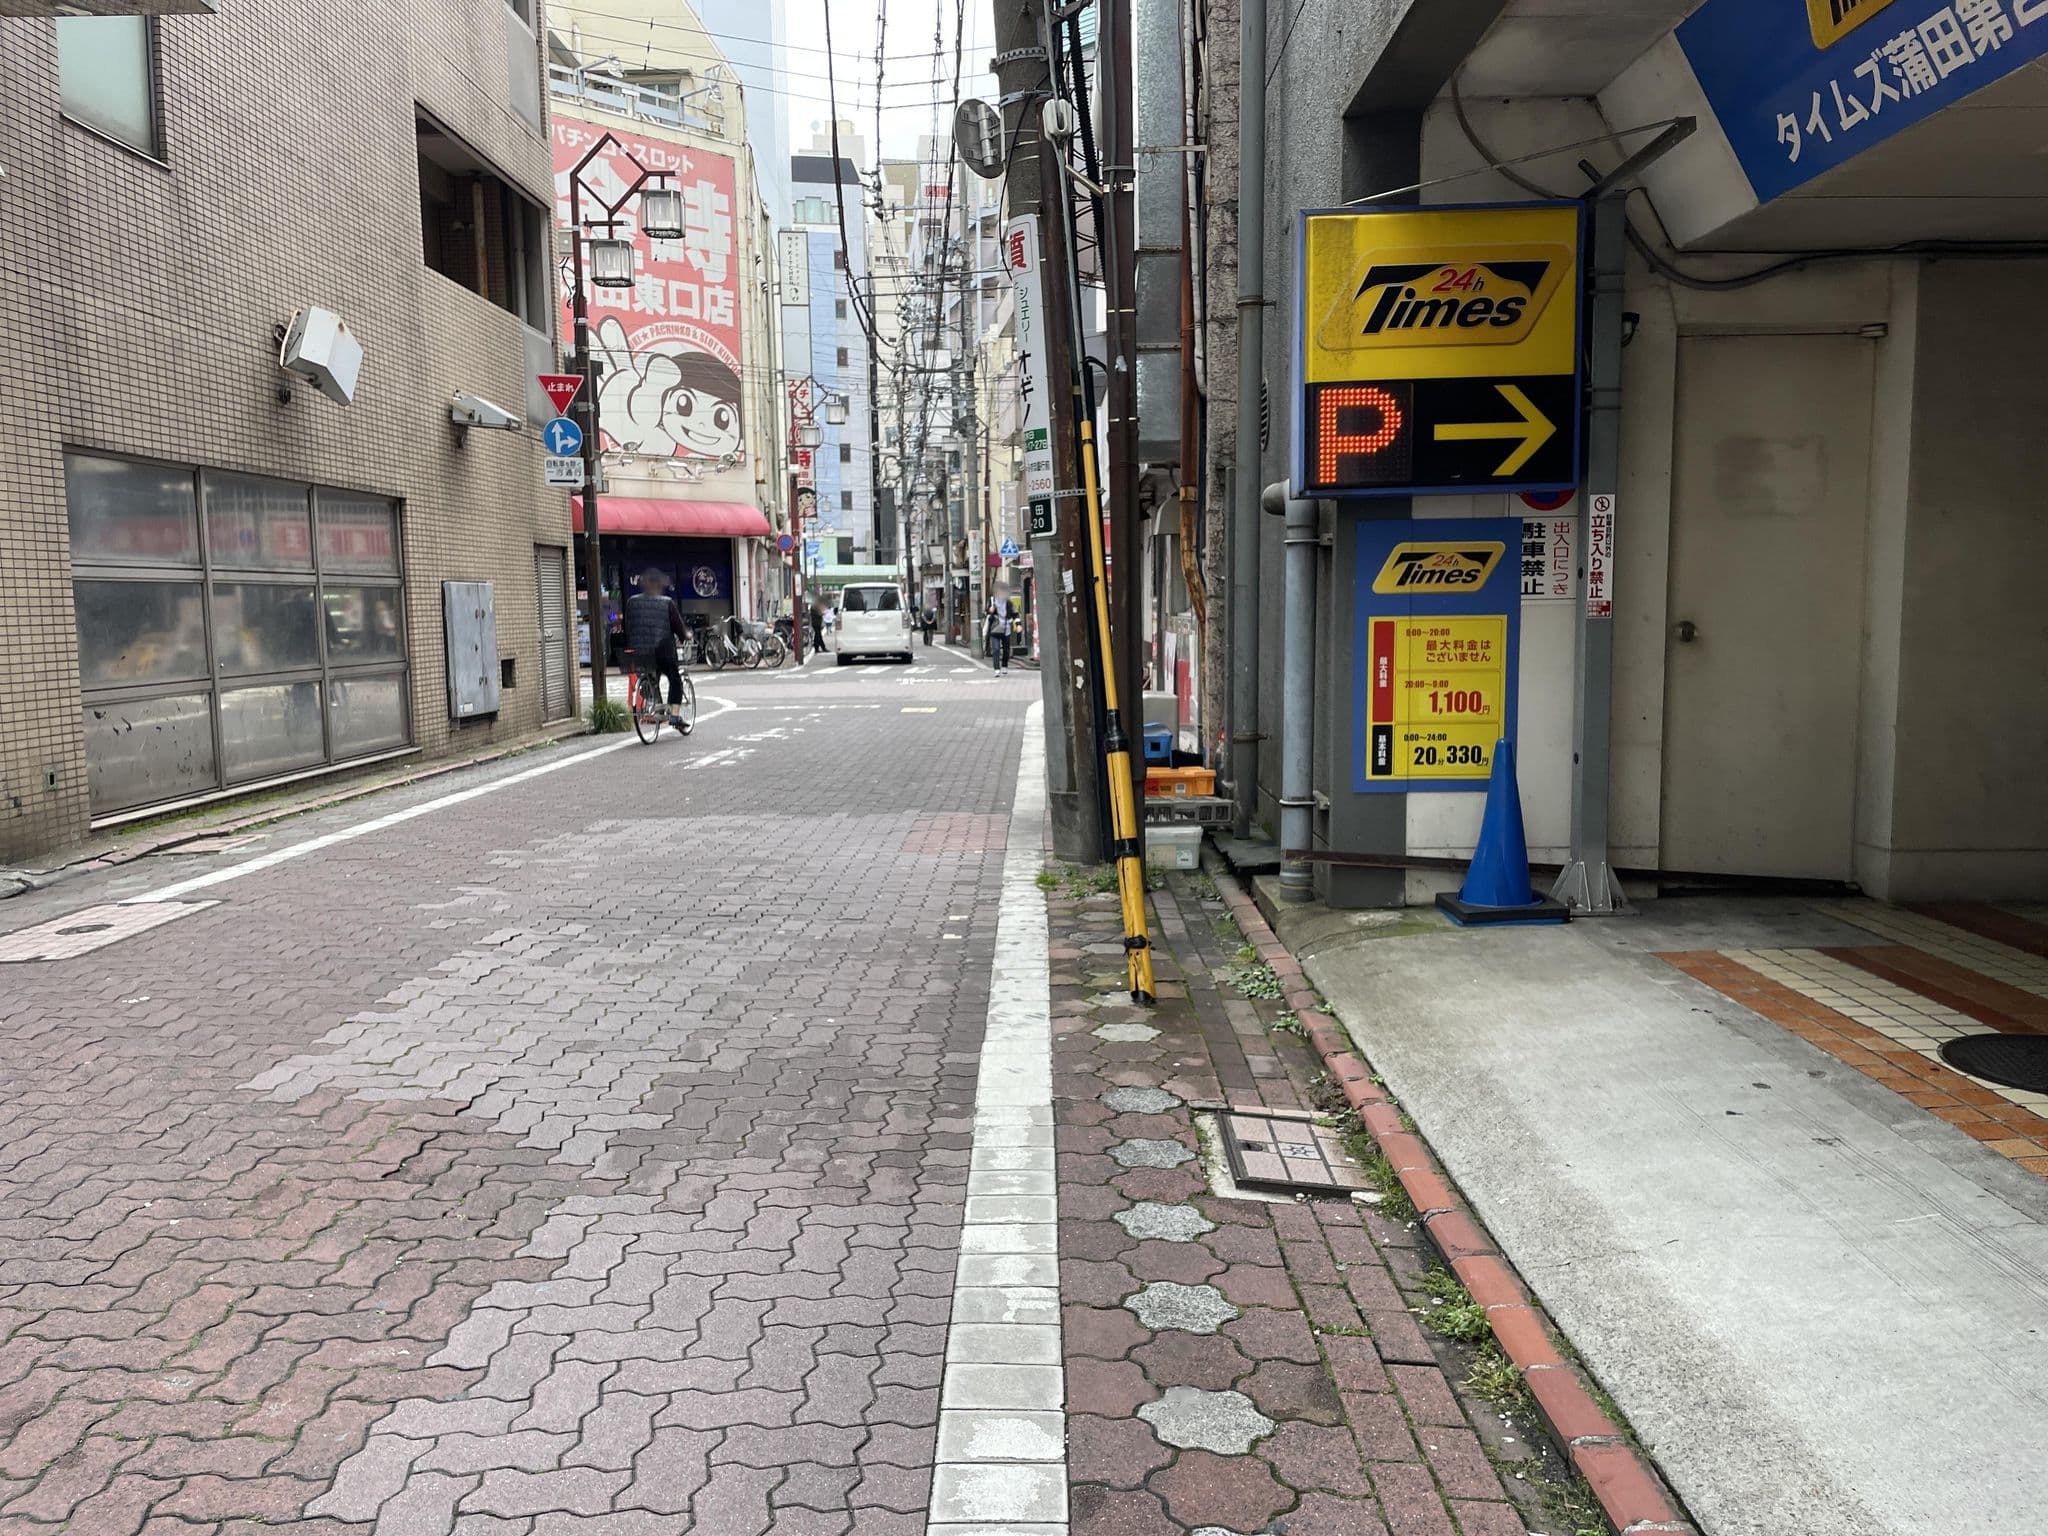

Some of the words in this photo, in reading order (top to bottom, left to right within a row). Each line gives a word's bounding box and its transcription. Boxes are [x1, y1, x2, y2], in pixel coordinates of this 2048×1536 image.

[1358, 281, 1528, 334] Times
[1431, 268, 1484, 294] 24h
[547, 382, 575, 393] 止まれ
[1018, 349, 1034, 427] オギノ
[1319, 387, 1402, 484] P
[1395, 562, 1483, 587] Times
[1521, 522, 1547, 595] 駐車禁止
[1552, 521, 1570, 595] 出入口につき
[1588, 514, 1606, 599] 立ち入り禁止
[1426, 640, 1492, 651] 最大料金は
[1426, 653, 1491, 662] ございません
